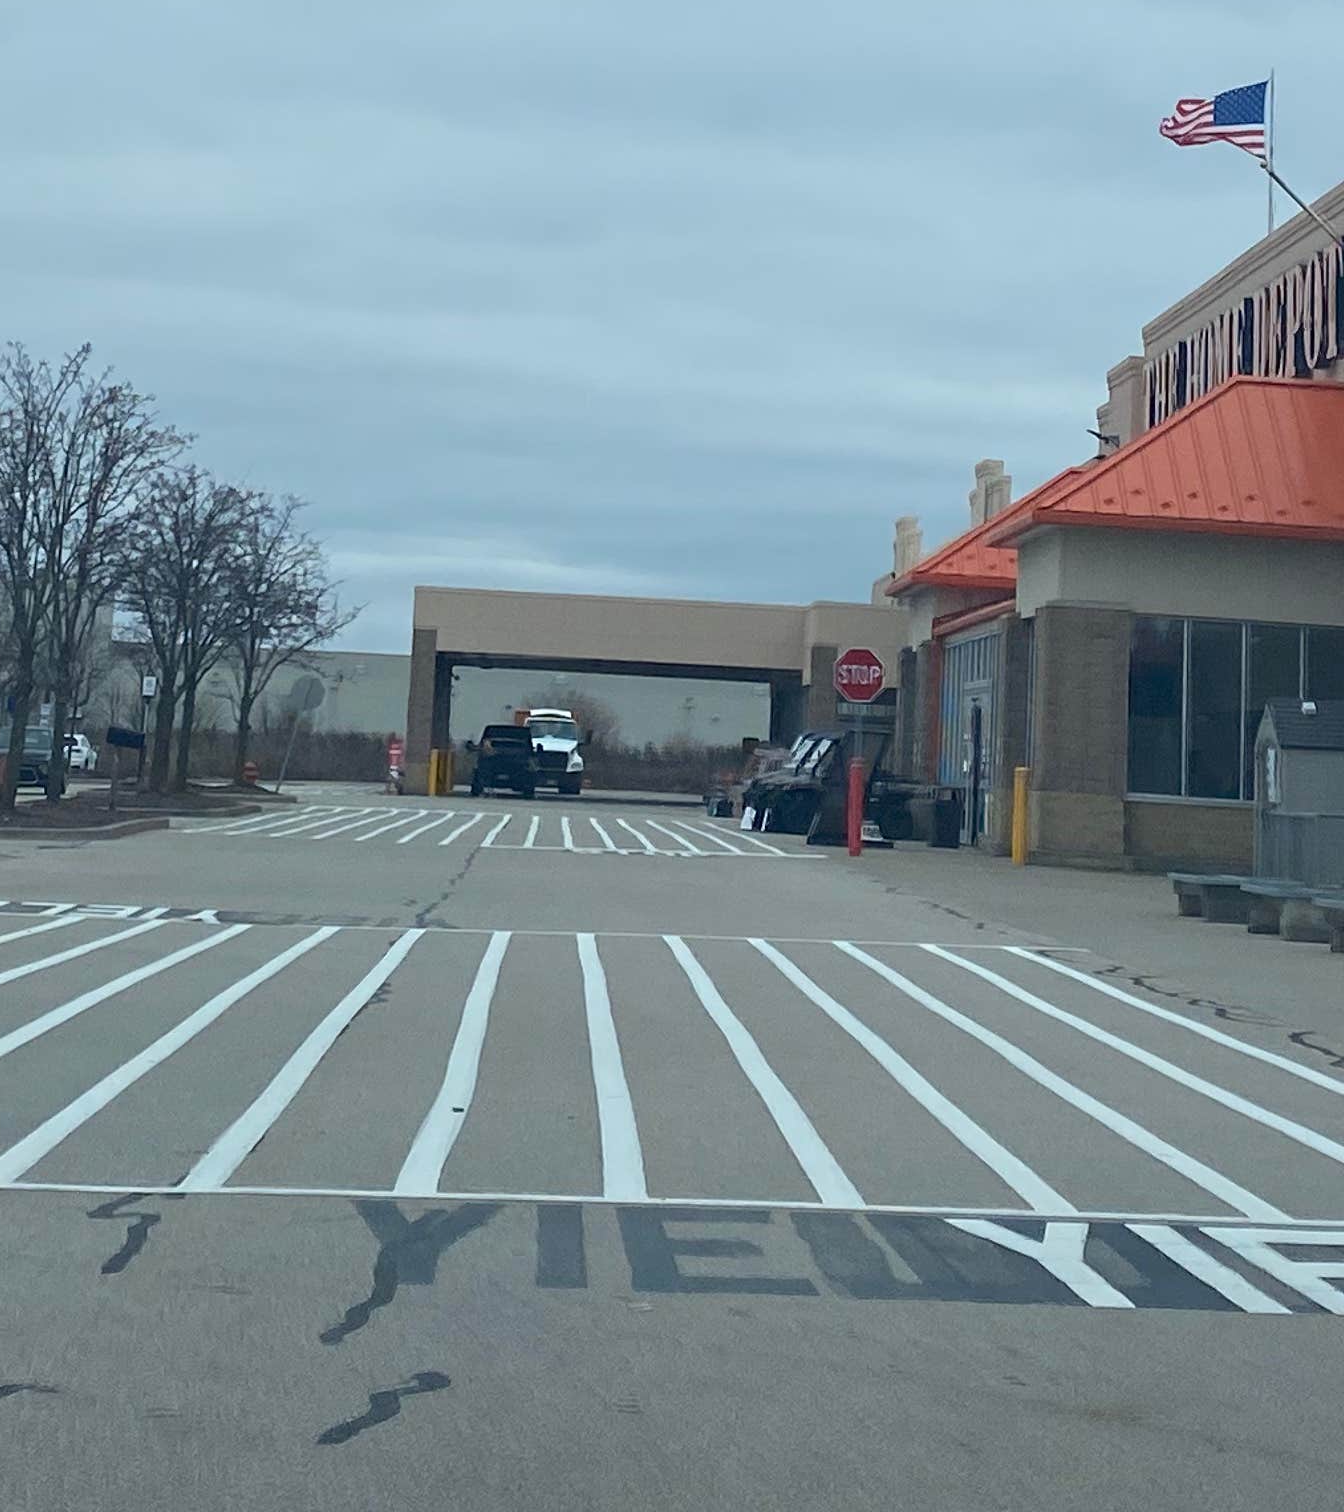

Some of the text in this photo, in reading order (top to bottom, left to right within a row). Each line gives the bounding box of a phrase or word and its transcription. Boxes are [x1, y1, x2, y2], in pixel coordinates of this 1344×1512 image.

[1186, 299, 1245, 405] HOME
[1253, 243, 1344, 378] DEPOT
[837, 664, 881, 685] STOP
